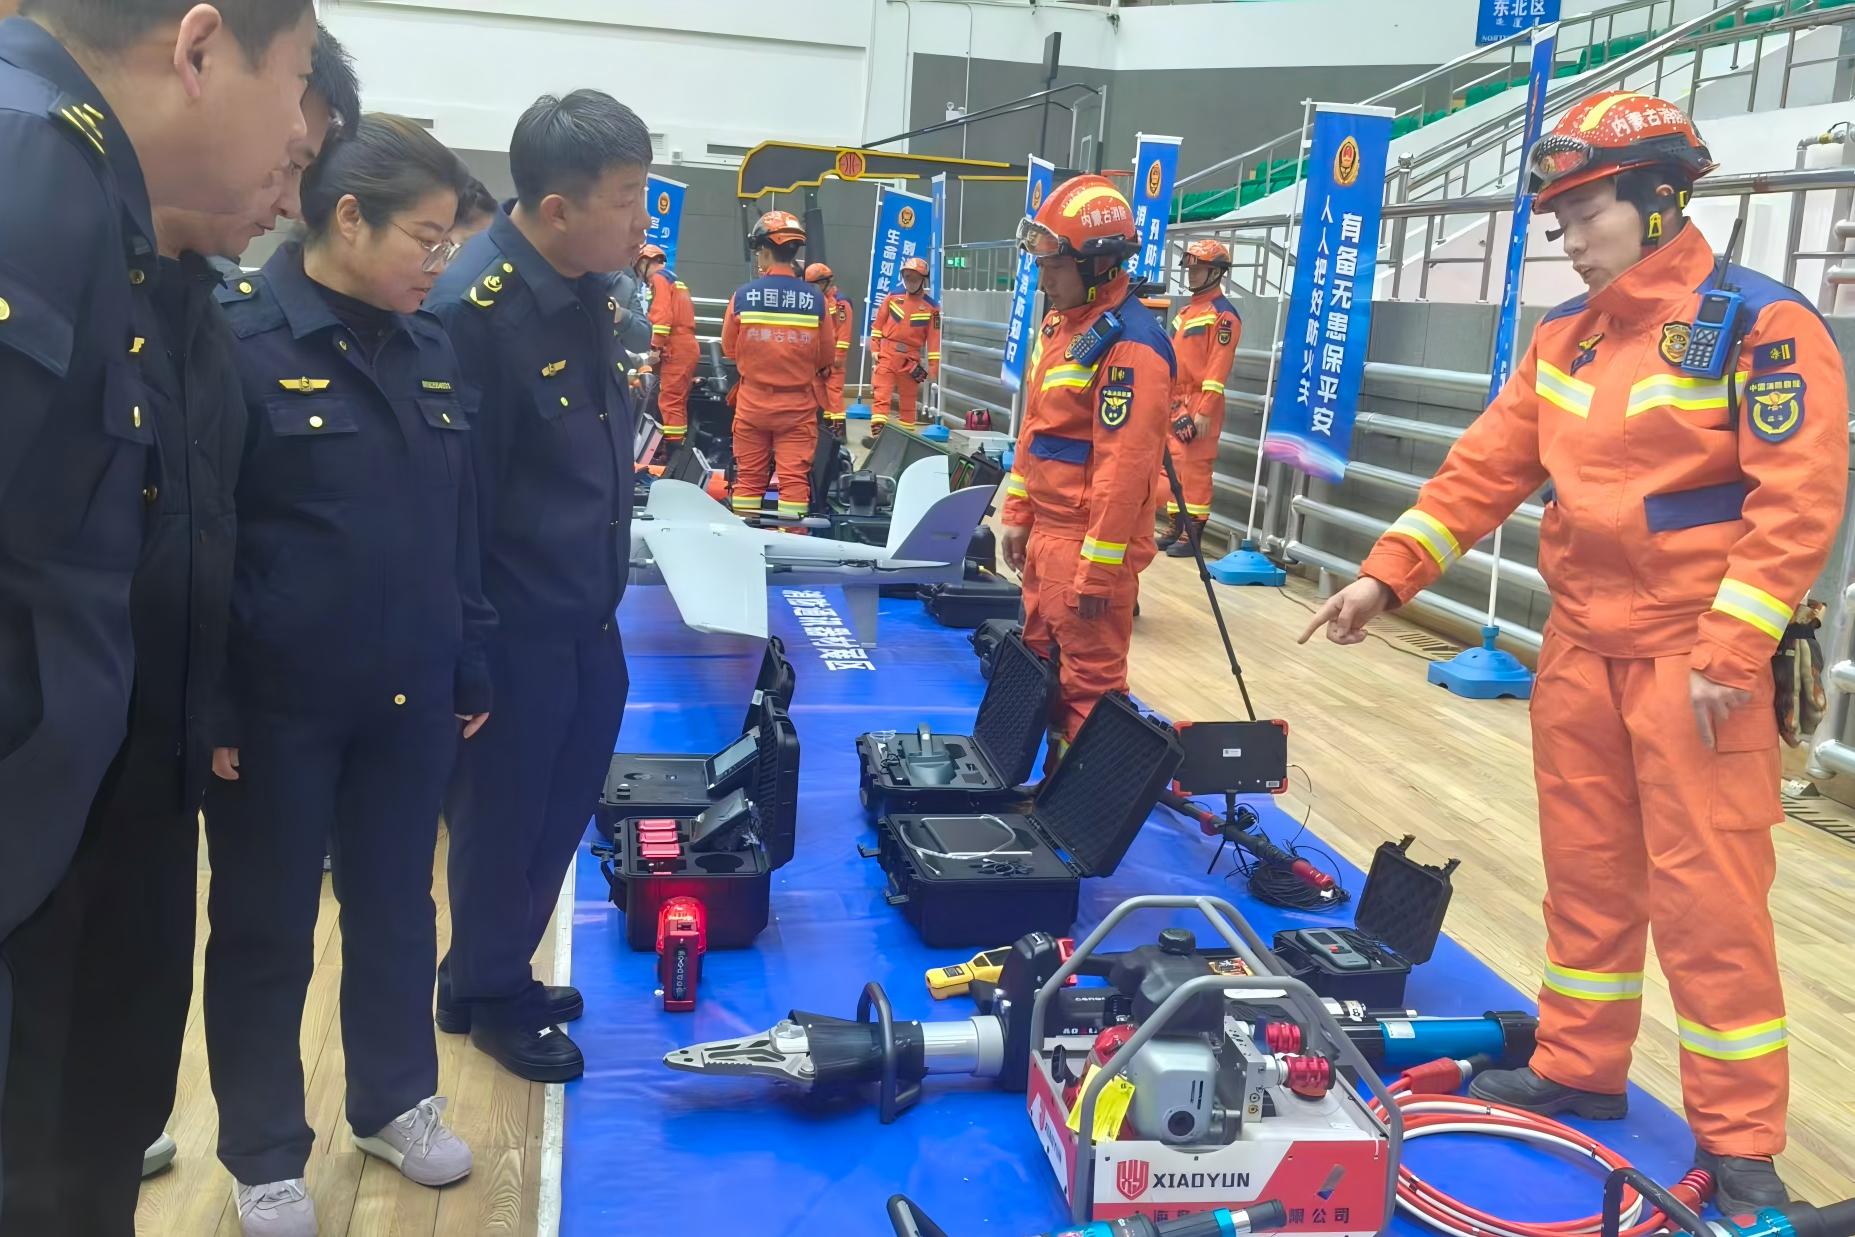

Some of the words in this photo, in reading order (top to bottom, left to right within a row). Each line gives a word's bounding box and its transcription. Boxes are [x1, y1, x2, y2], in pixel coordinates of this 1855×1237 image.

[1493, 0, 1546, 17] 东北区
[746, 288, 815, 310] 中国消防
[1297, 194, 1334, 407] 人人把好防火关
[1311, 212, 1363, 438] 有备无患保平安
[1152, 1172, 1250, 1189] XIAOYUN
